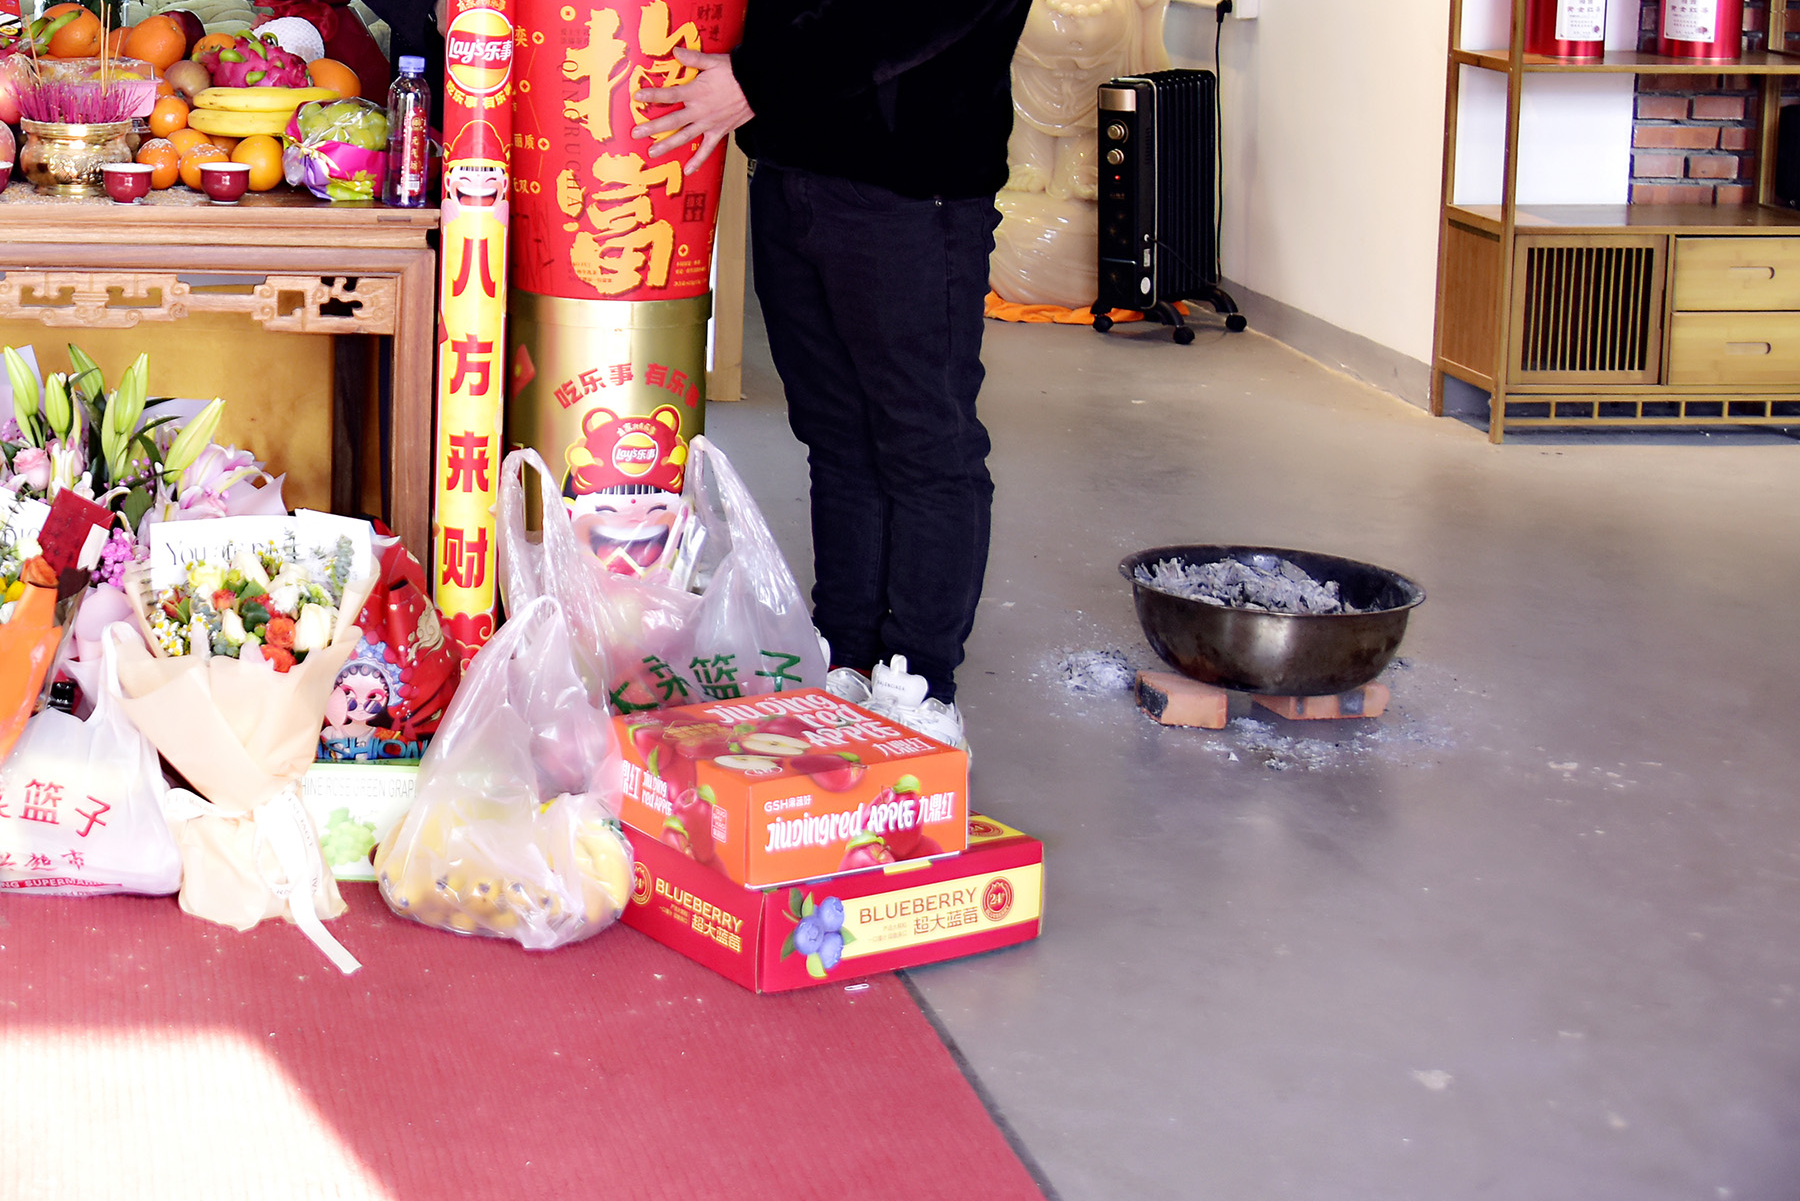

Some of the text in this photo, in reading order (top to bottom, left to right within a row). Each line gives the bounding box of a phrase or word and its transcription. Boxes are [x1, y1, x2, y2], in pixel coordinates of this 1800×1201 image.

[553, 362, 700, 409] 吃乐事 有乐事
[441, 237, 496, 589] 八方来财
[794, 704, 872, 729] red
[800, 720, 902, 748] APPLE
[872, 737, 937, 757] 九鼎红
[389, 779, 417, 798] GRAP
[916, 792, 955, 824] 九鼎红
[655, 877, 744, 932] BLUEBERRY
[859, 886, 977, 925] BLUEBERRY
[691, 913, 742, 953] 超大蓝莓
[913, 906, 979, 936] 超大蓝莓
